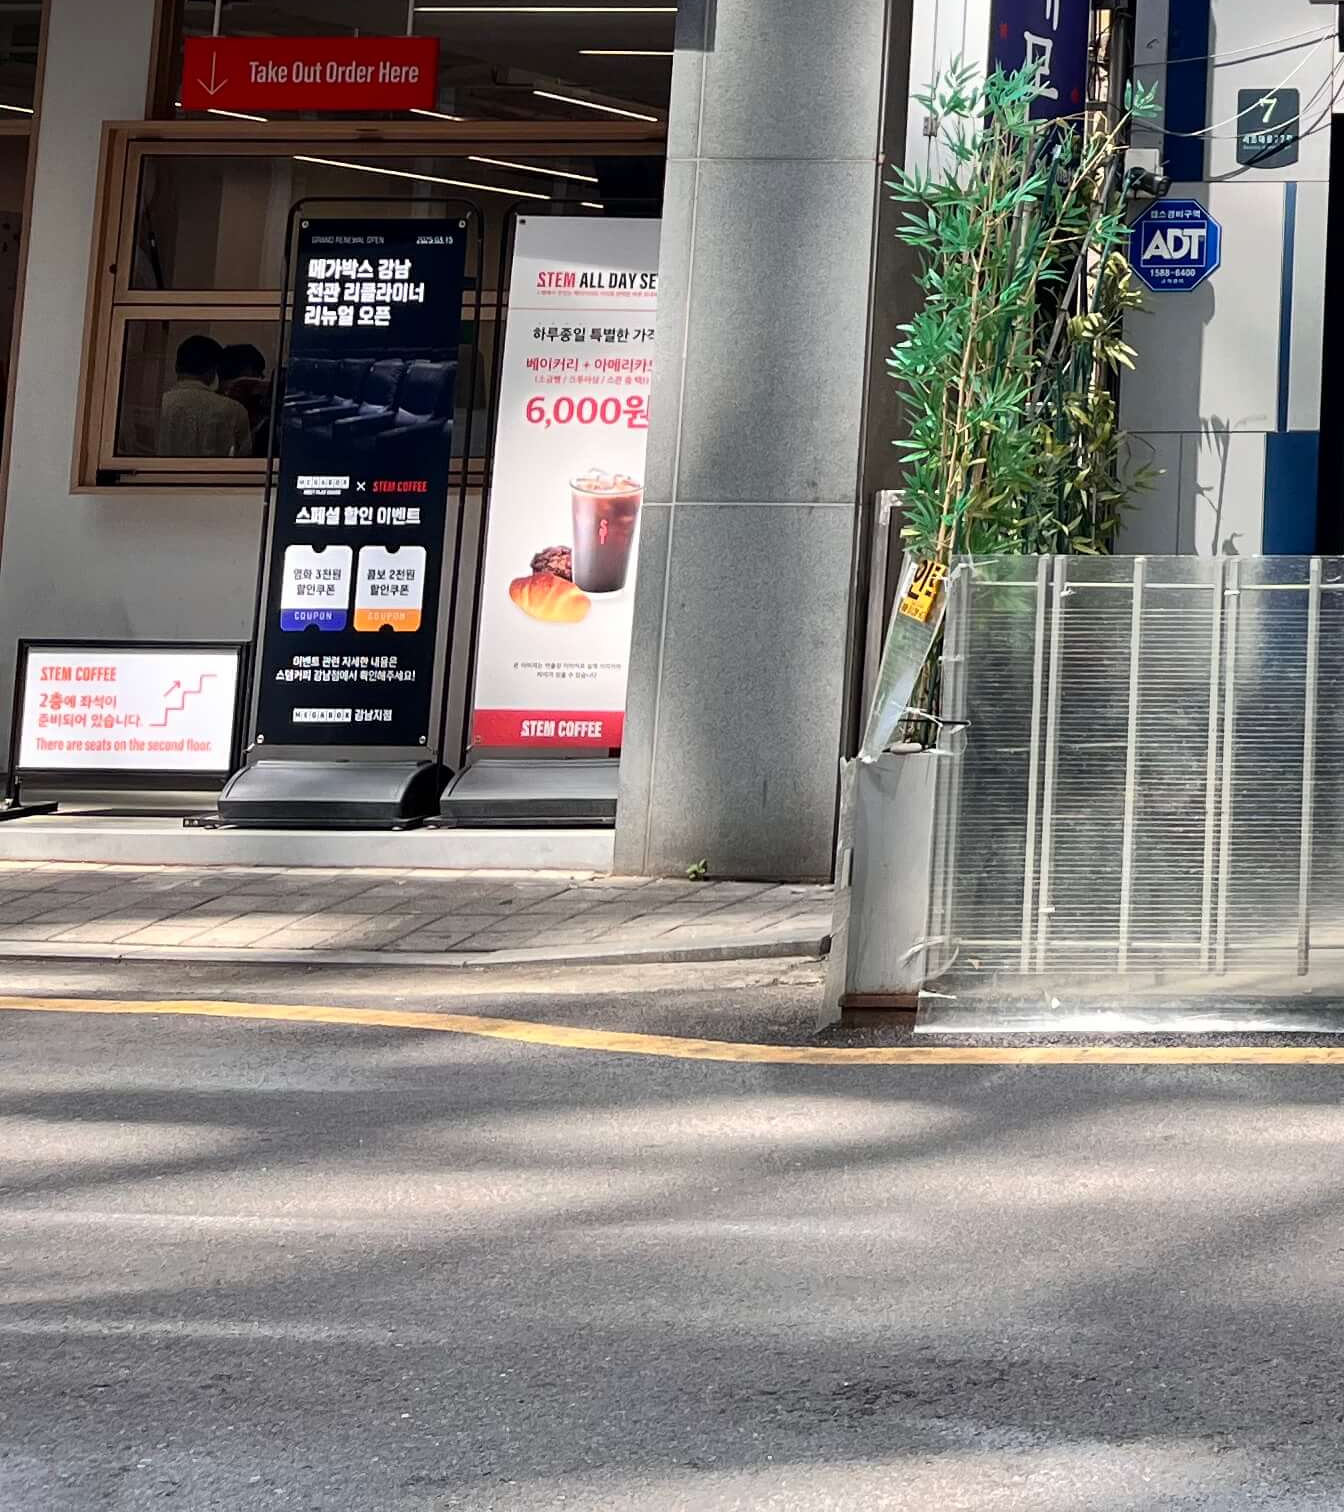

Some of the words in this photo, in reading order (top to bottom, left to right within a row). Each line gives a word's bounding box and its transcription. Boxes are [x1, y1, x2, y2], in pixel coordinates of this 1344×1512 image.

[248, 60, 289, 85] Take
[292, 60, 323, 85] Out
[326, 60, 375, 85] Order
[378, 60, 419, 85] Here
[1258, 98, 1278, 123] 7
[1143, 227, 1207, 260] ADT
[308, 258, 375, 280] 메가박스
[378, 258, 412, 280] 강남
[537, 271, 576, 288] STEM
[579, 271, 605, 289] ALL
[608, 272, 638, 289] DAY
[640, 272, 659, 290] SE
[304, 306, 354, 326] 리뉴얼
[357, 306, 392, 326] 오픈
[589, 326, 630, 343] 특별한
[526, 357, 579, 372] 베이커리
[526, 395, 651, 429] 6,000원
[372, 480, 396, 493] STEM
[397, 480, 428, 493] COFFEE
[295, 506, 340, 525] 스페셜
[344, 506, 373, 525] 할인
[376, 506, 421, 525] 이벤트
[294, 611, 333, 621] COUPON
[367, 611, 406, 621] COUPON
[292, 655, 320, 667] 이벤트
[40, 666, 72, 682] STEM
[75, 666, 117, 682] COFFEE
[39, 692, 77, 709] 2층에
[79, 693, 118, 708] 좌석이
[38, 714, 88, 728] 준비되어
[292, 707, 352, 723] MEGABOX
[521, 720, 555, 737] STEM
[558, 721, 604, 738] COFFEE
[36, 737, 64, 752] There
[66, 738, 82, 752] are
[84, 738, 112, 752] seats
[114, 738, 127, 752] on
[129, 738, 145, 752] the
[147, 738, 184, 752] second
